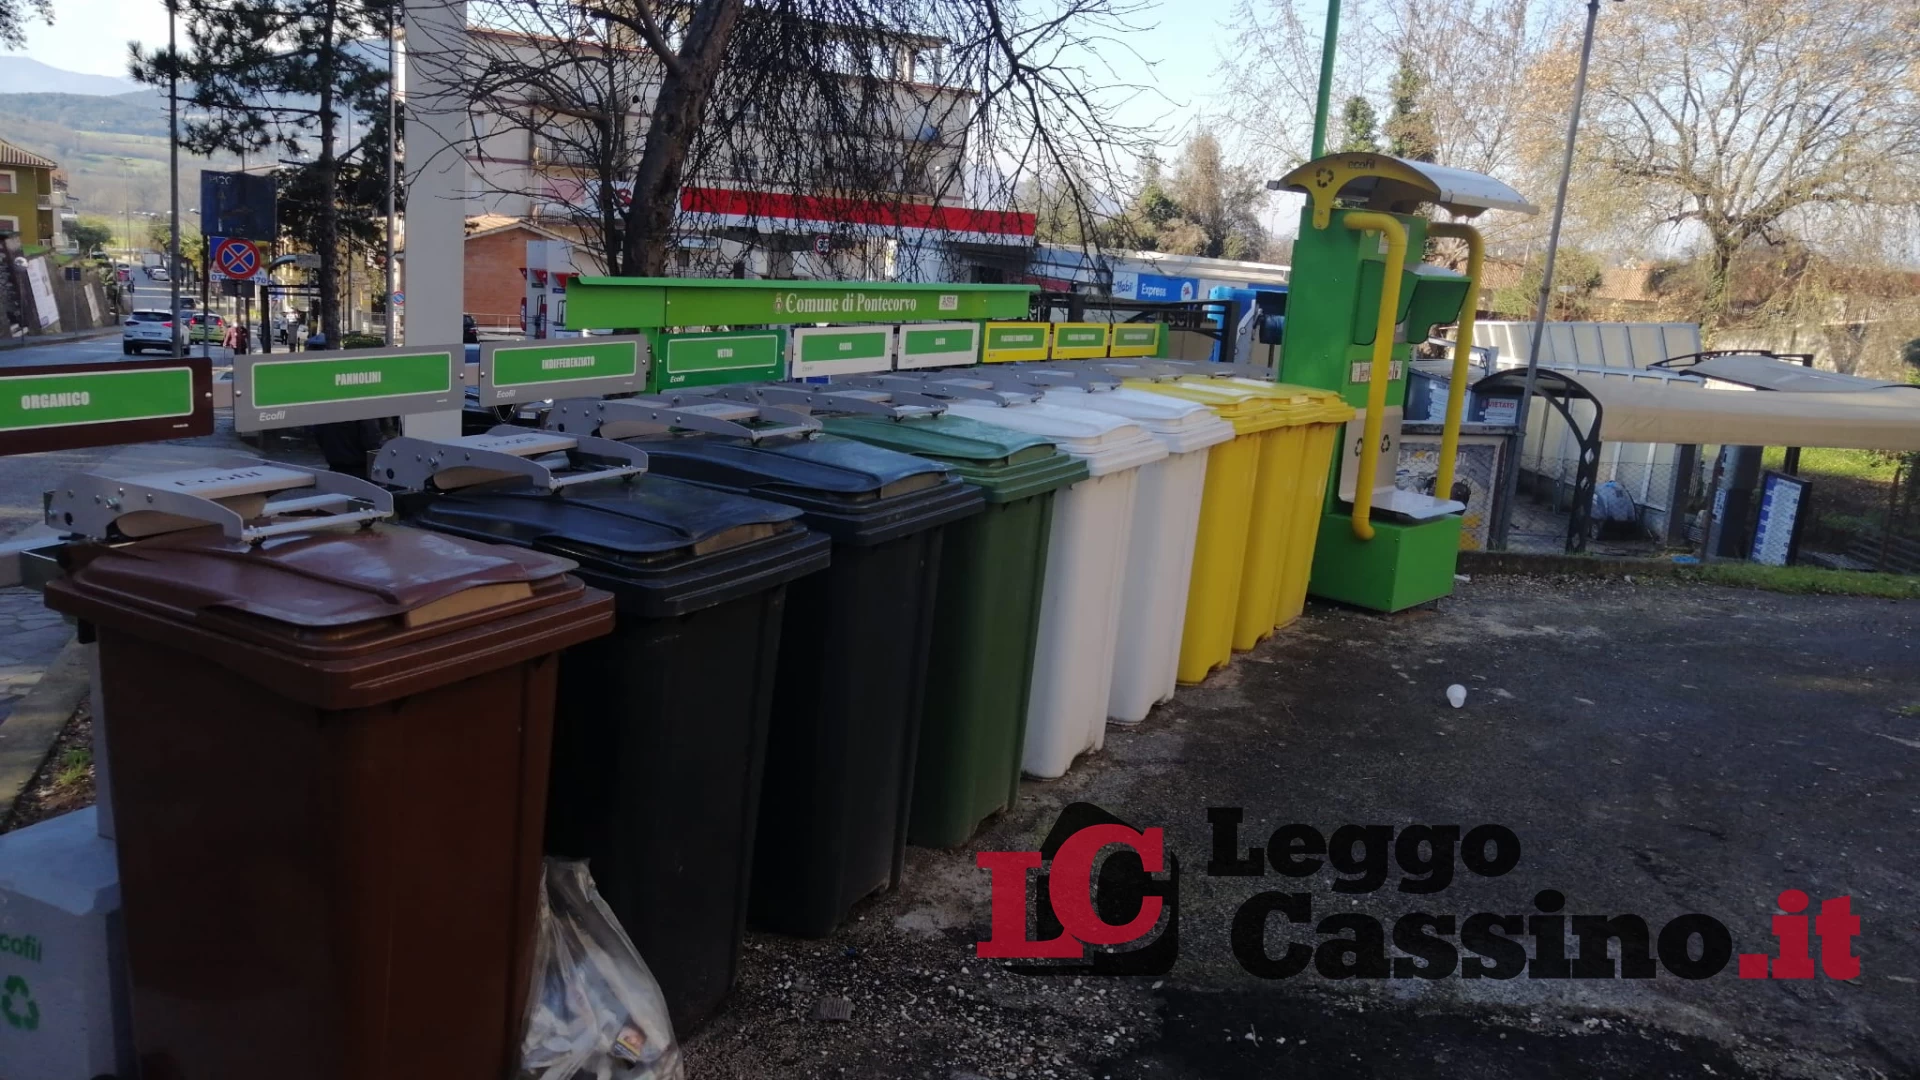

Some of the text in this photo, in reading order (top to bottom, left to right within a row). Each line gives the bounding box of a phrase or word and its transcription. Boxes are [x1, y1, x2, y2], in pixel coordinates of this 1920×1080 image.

[1141, 283, 1167, 298] Express
[785, 293, 838, 313] Comune
[842, 292, 854, 312] di
[857, 293, 917, 312] Pontecorvo
[717, 348, 734, 359] VETRO
[541, 356, 595, 370] INDIFFERENZIATO
[335, 371, 382, 386] PANNOLINI
[21, 391, 91, 410] ORGANICO
[496, 389, 516, 398] Ecofil
[1486, 401, 1515, 410] VIETATO
[259, 410, 286, 422] Ecofil
